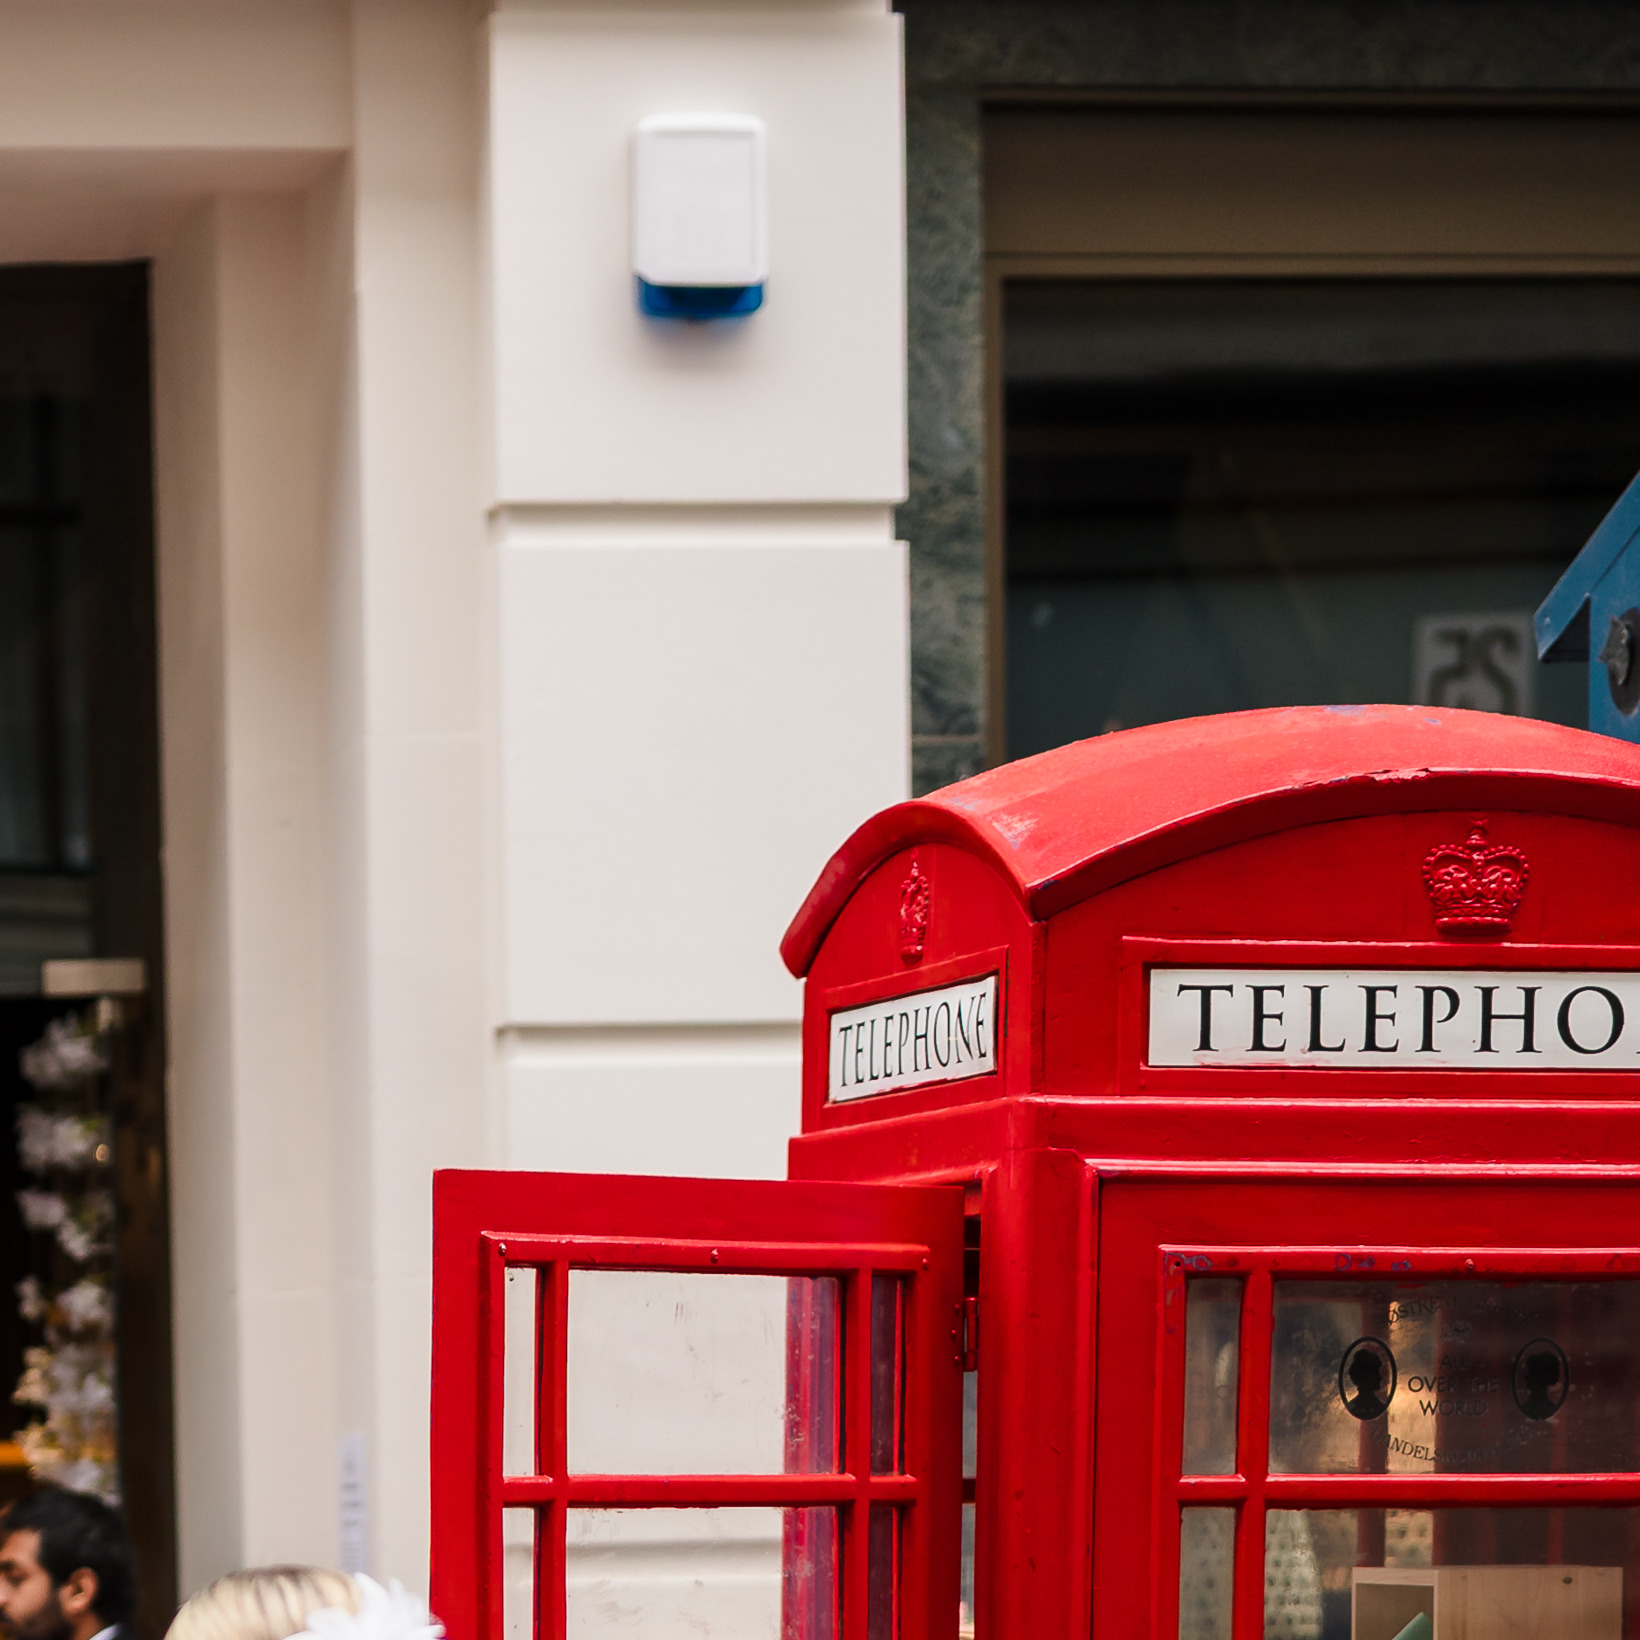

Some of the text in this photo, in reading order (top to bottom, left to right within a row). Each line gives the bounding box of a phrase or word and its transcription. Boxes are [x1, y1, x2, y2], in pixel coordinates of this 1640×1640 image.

[837, 991, 988, 1087] TELEPHONE
[1177, 984, 1640, 1054] TELEPHO
[1408, 1376, 1499, 1393] OVER THE
[1419, 1400, 1487, 1416] WORLD
